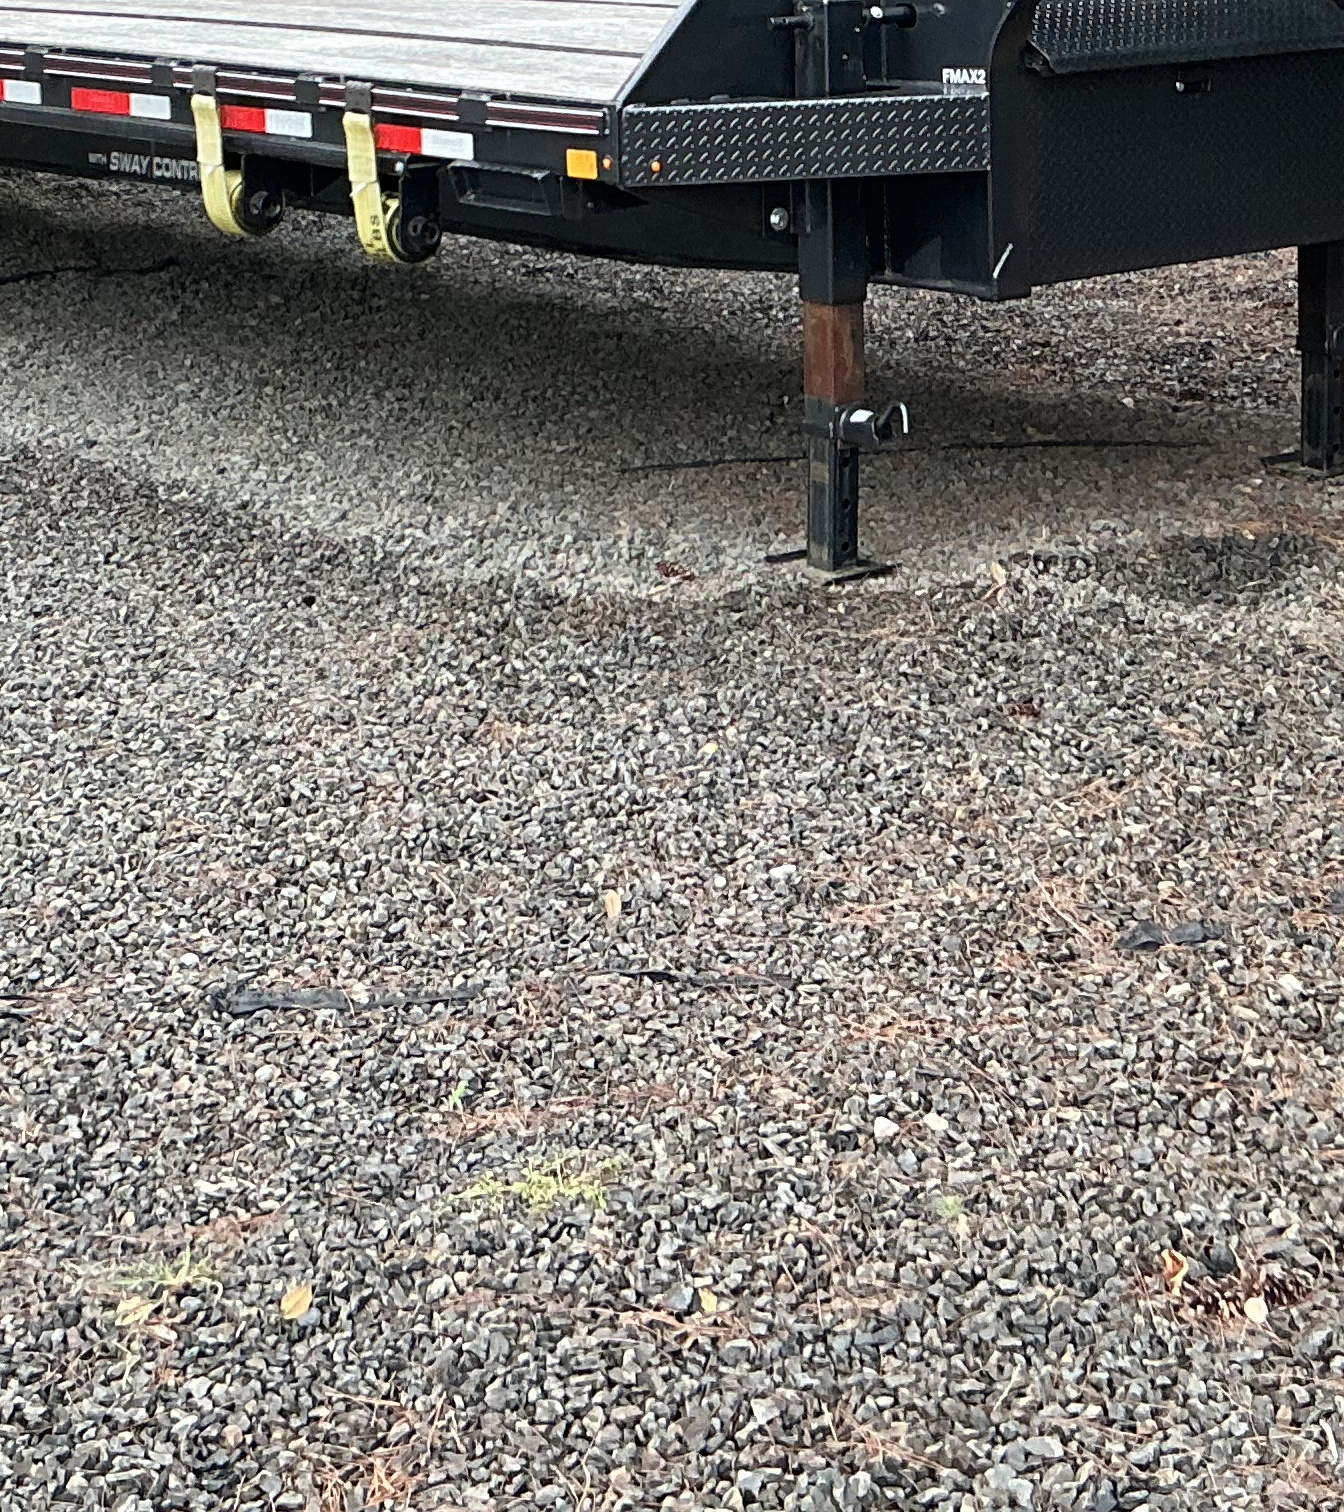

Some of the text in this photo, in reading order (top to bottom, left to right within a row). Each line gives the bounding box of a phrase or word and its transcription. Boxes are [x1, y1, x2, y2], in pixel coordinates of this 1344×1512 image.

[942, 68, 987, 85] FMAX2
[109, 151, 151, 175] SWAY
[152, 156, 202, 182] CONTR
